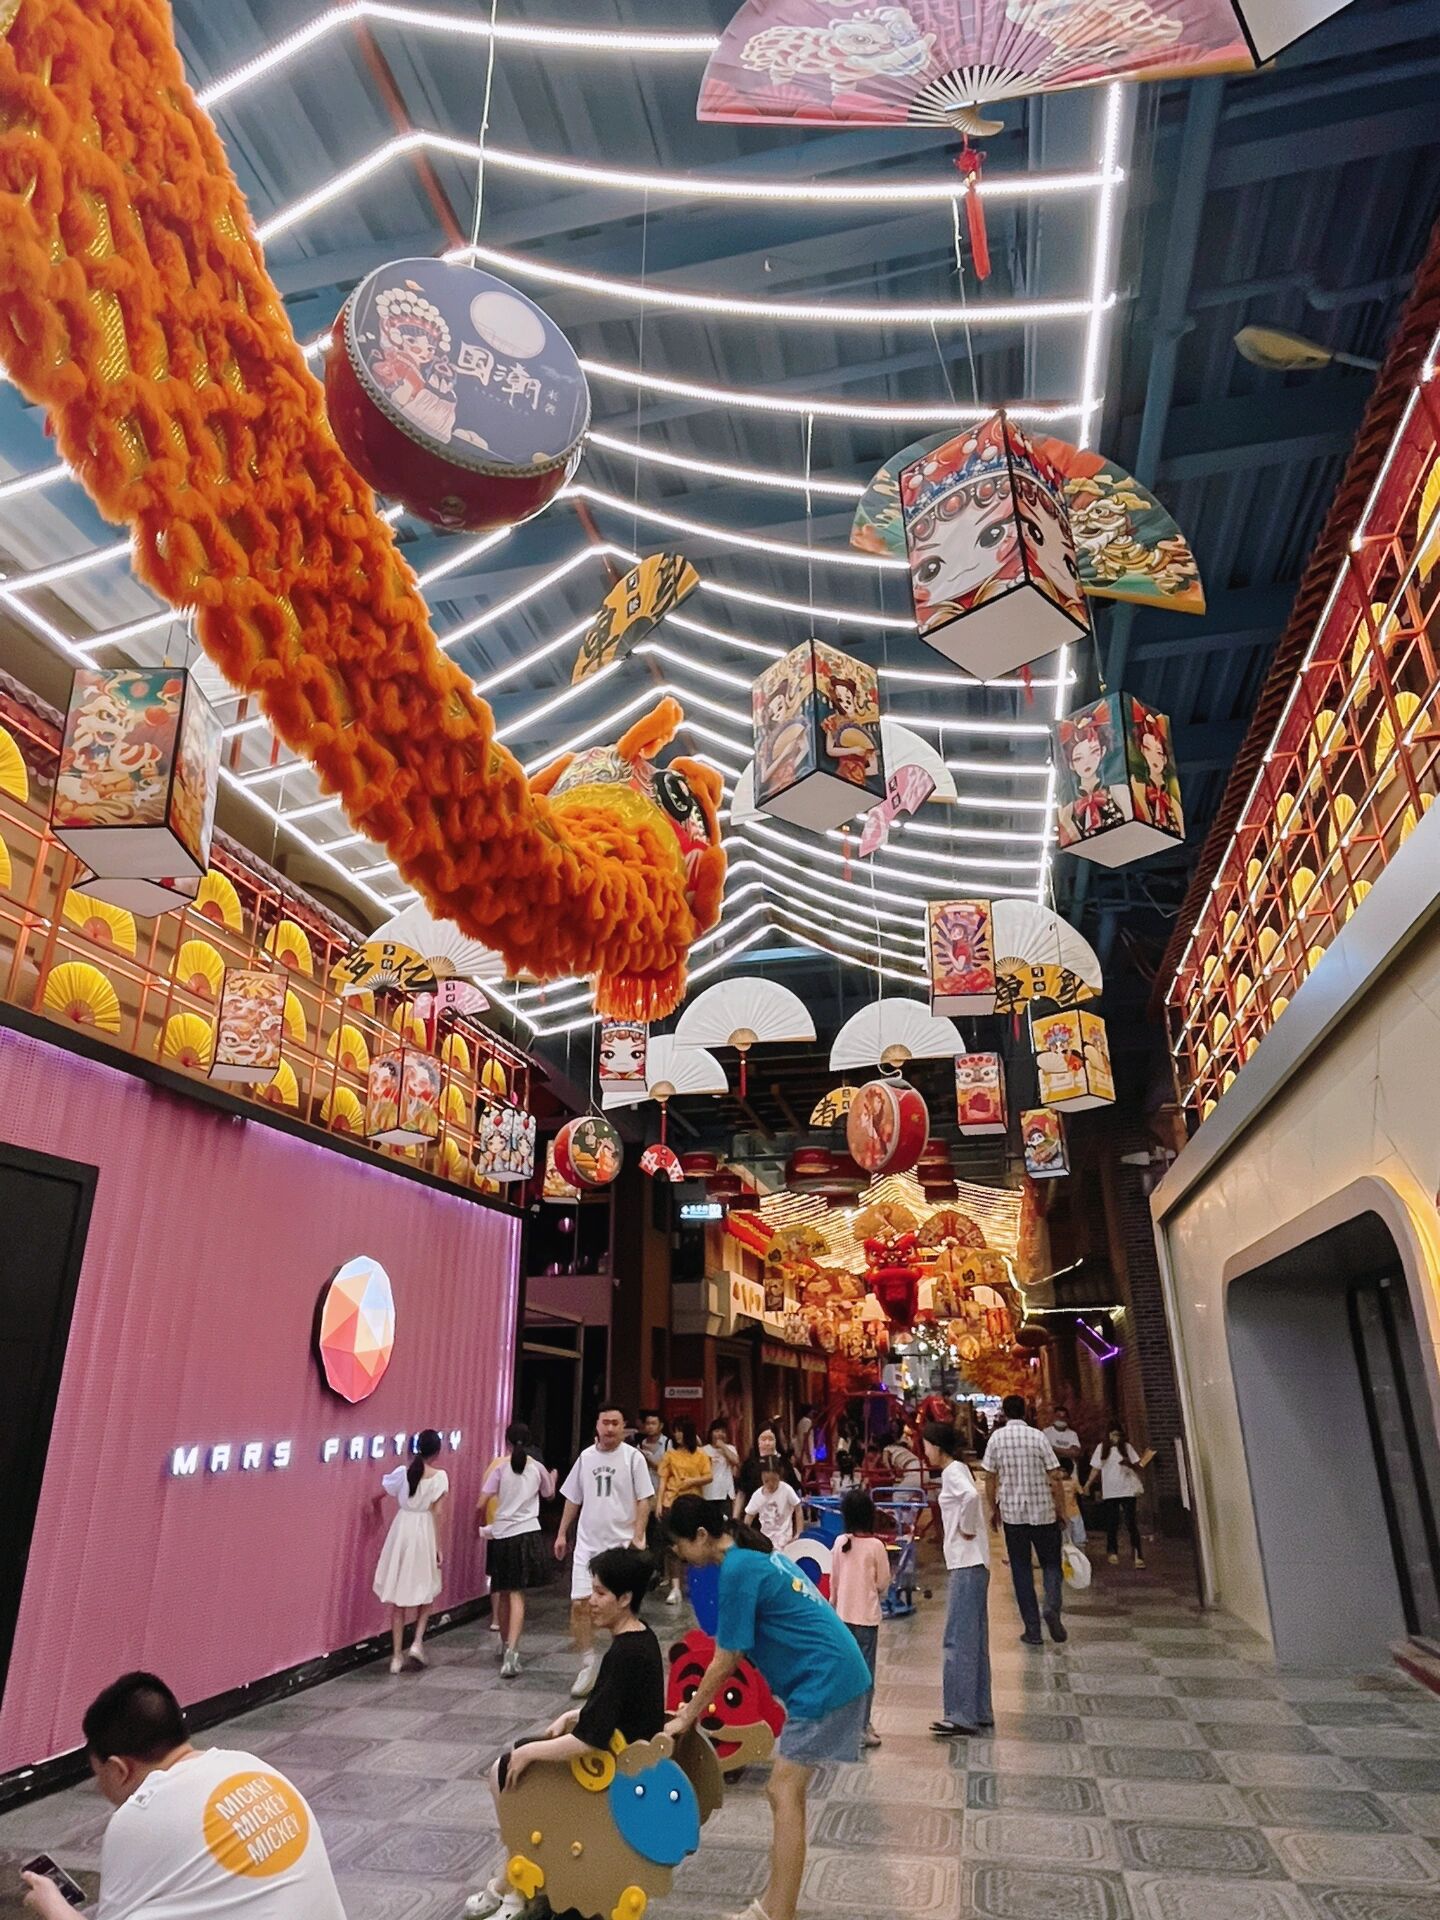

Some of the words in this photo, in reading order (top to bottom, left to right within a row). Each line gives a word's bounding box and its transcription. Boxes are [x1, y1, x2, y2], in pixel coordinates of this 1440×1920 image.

[172, 1440, 291, 1476] MARS
[323, 1430, 462, 1463] FACTY
[595, 1475, 612, 1497] 11
[215, 1776, 273, 1820] MICKEY
[232, 1792, 288, 1840] MICKEY
[247, 1813, 301, 1866] MICKEY
